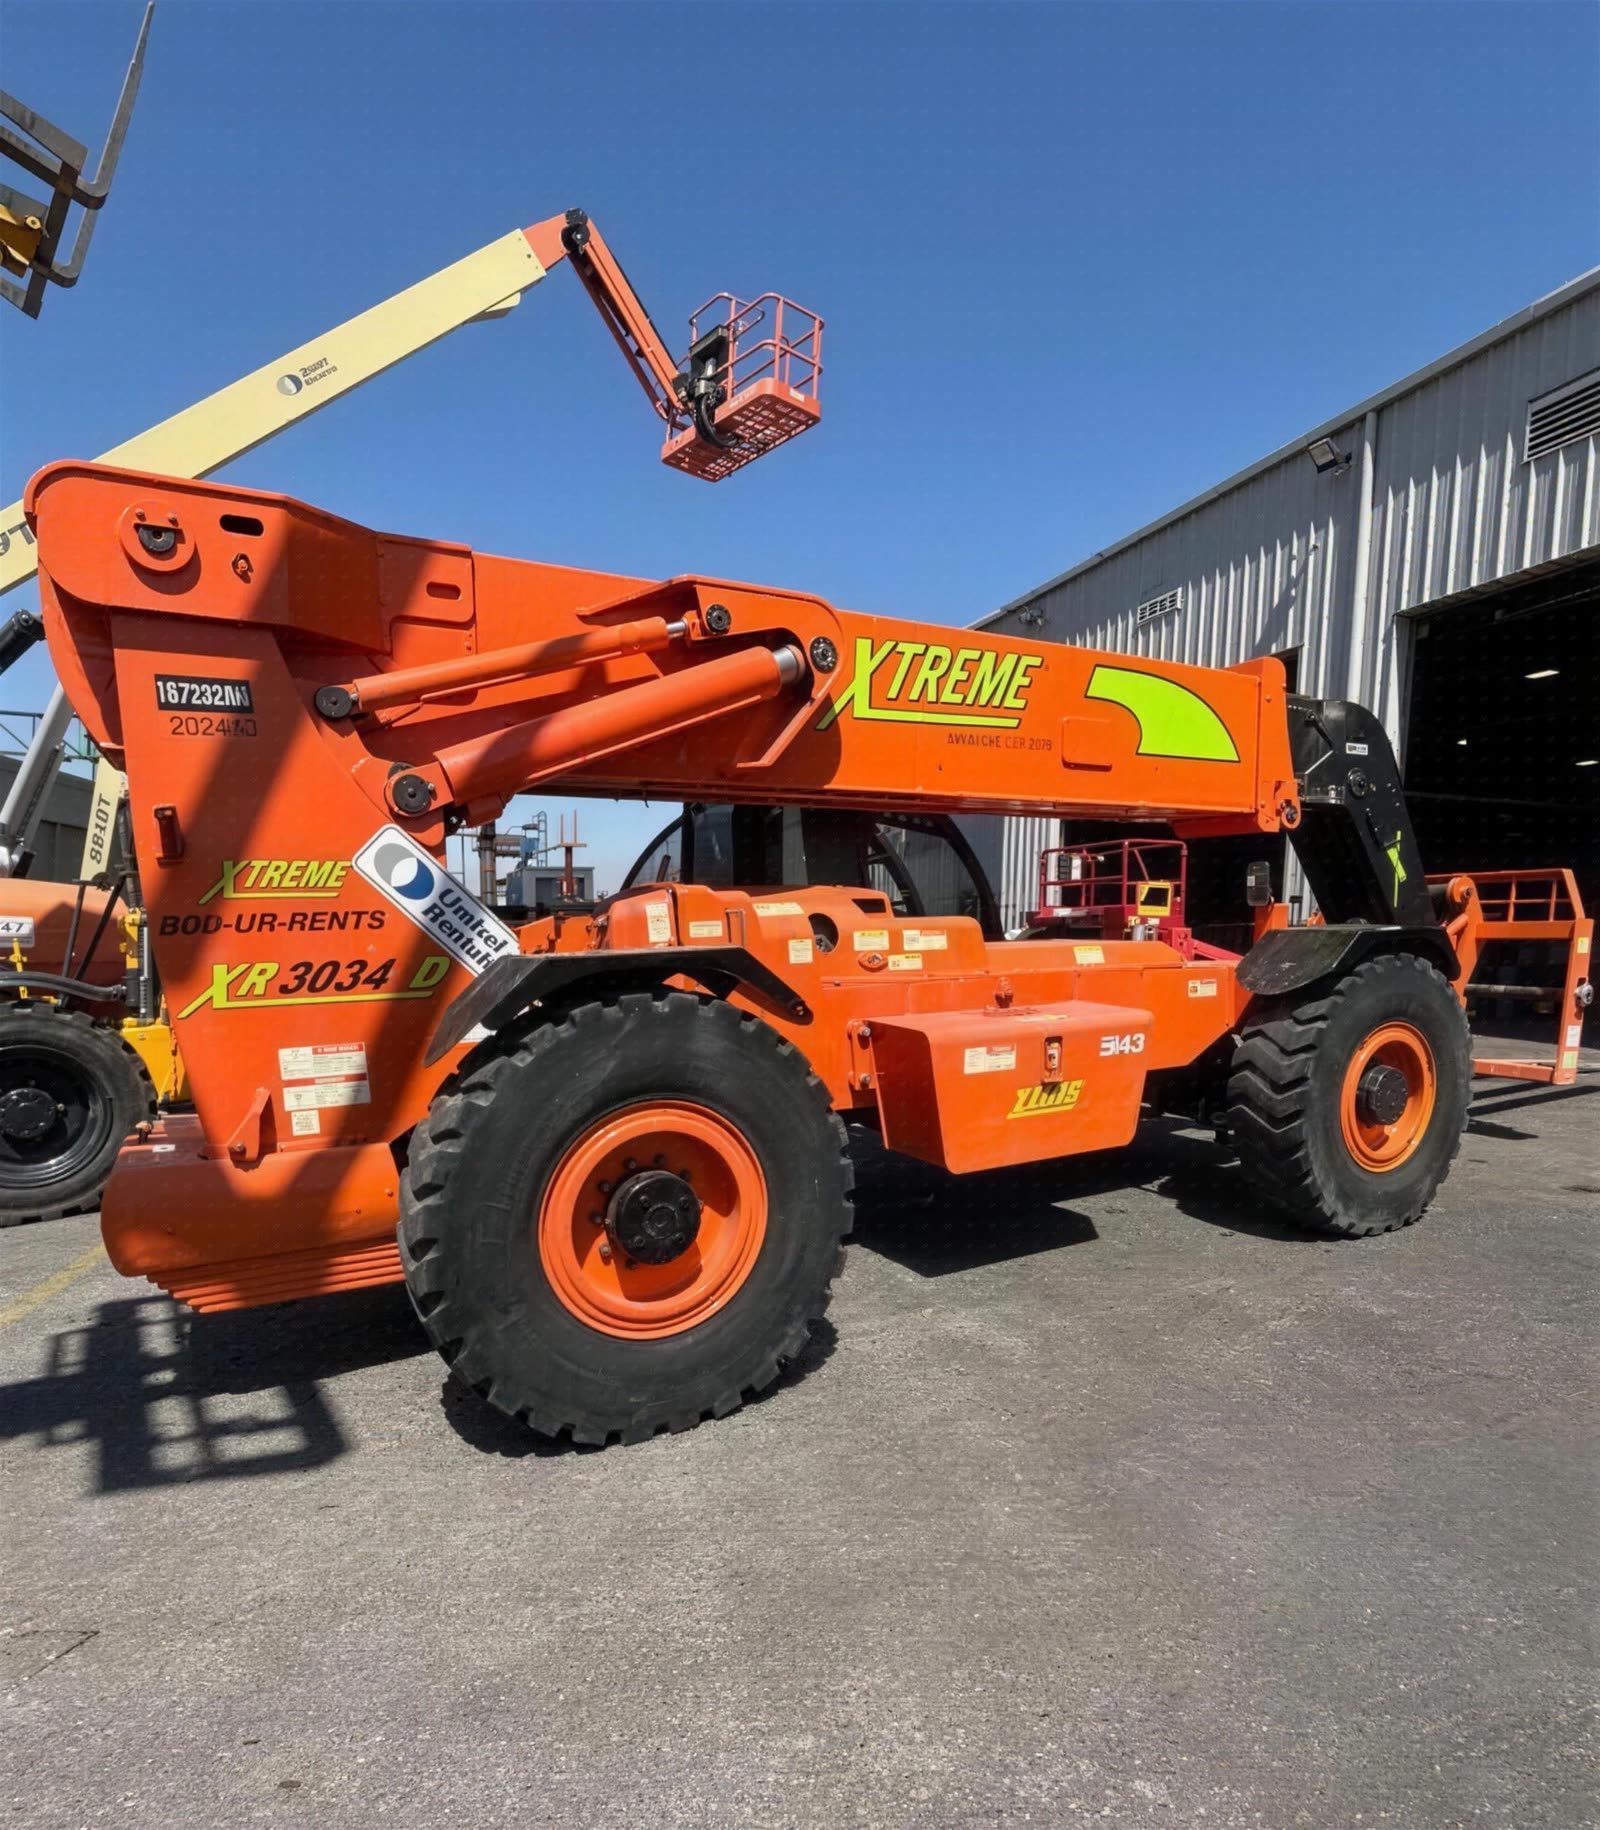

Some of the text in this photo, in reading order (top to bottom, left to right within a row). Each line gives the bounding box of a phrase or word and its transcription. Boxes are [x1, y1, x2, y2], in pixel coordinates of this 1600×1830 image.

[815, 638, 1043, 730] XTREME
[198, 860, 353, 904] XTREME
[159, 910, 387, 936] BOD-UR-RENTS
[176, 956, 450, 1020] XR 3034 D
